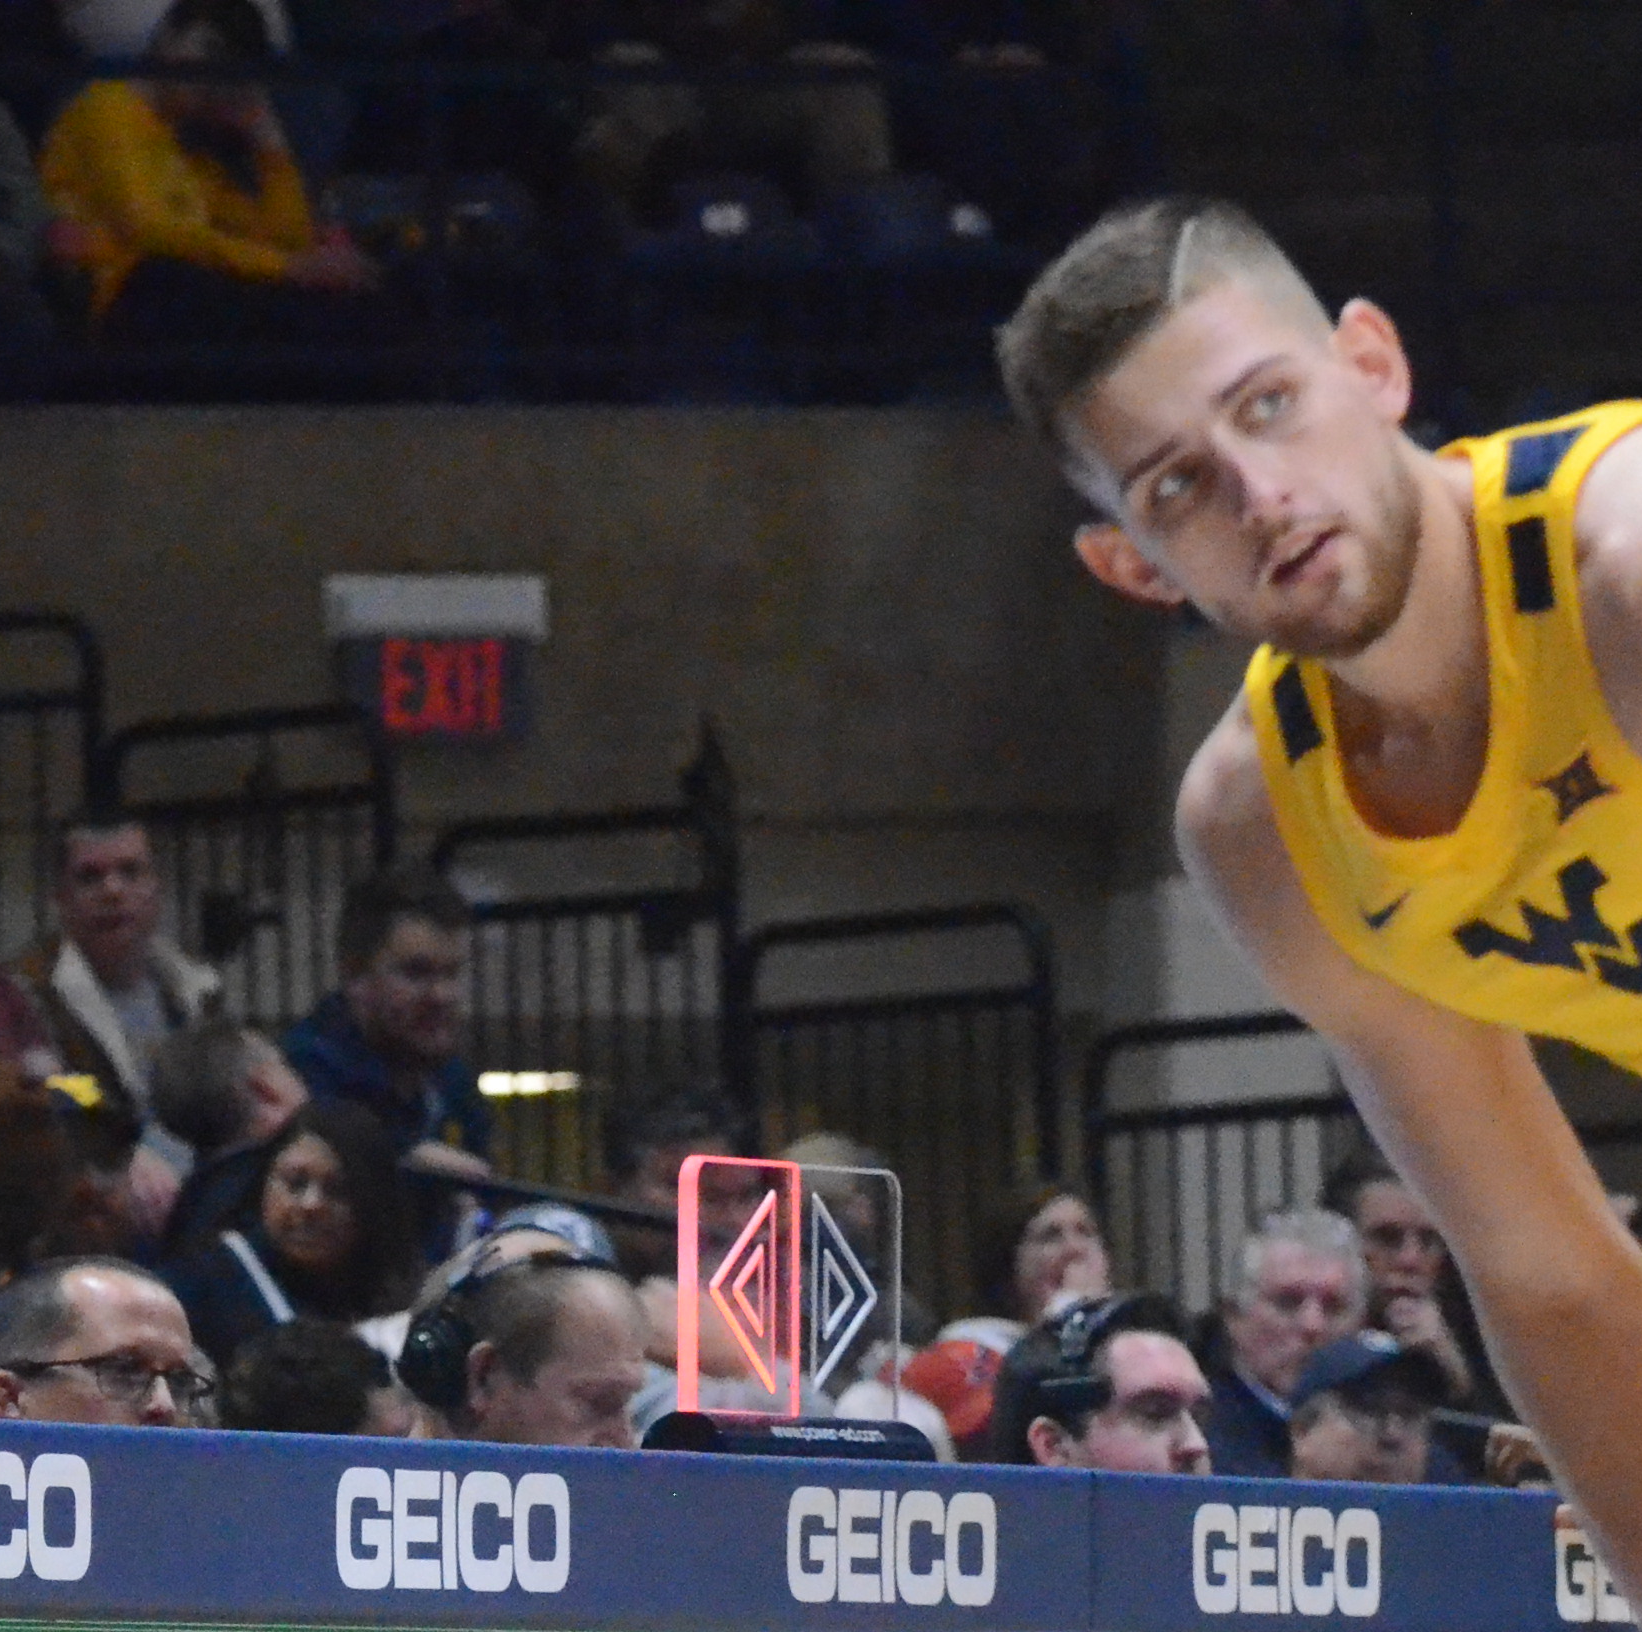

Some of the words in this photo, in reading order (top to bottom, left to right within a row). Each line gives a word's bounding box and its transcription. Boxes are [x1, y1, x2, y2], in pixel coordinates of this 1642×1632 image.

[383, 637, 504, 732] EXIT
[335, 1466, 571, 1593] GEICO
[786, 1486, 997, 1606] GEICO
[1192, 1503, 1381, 1617] GEICO
